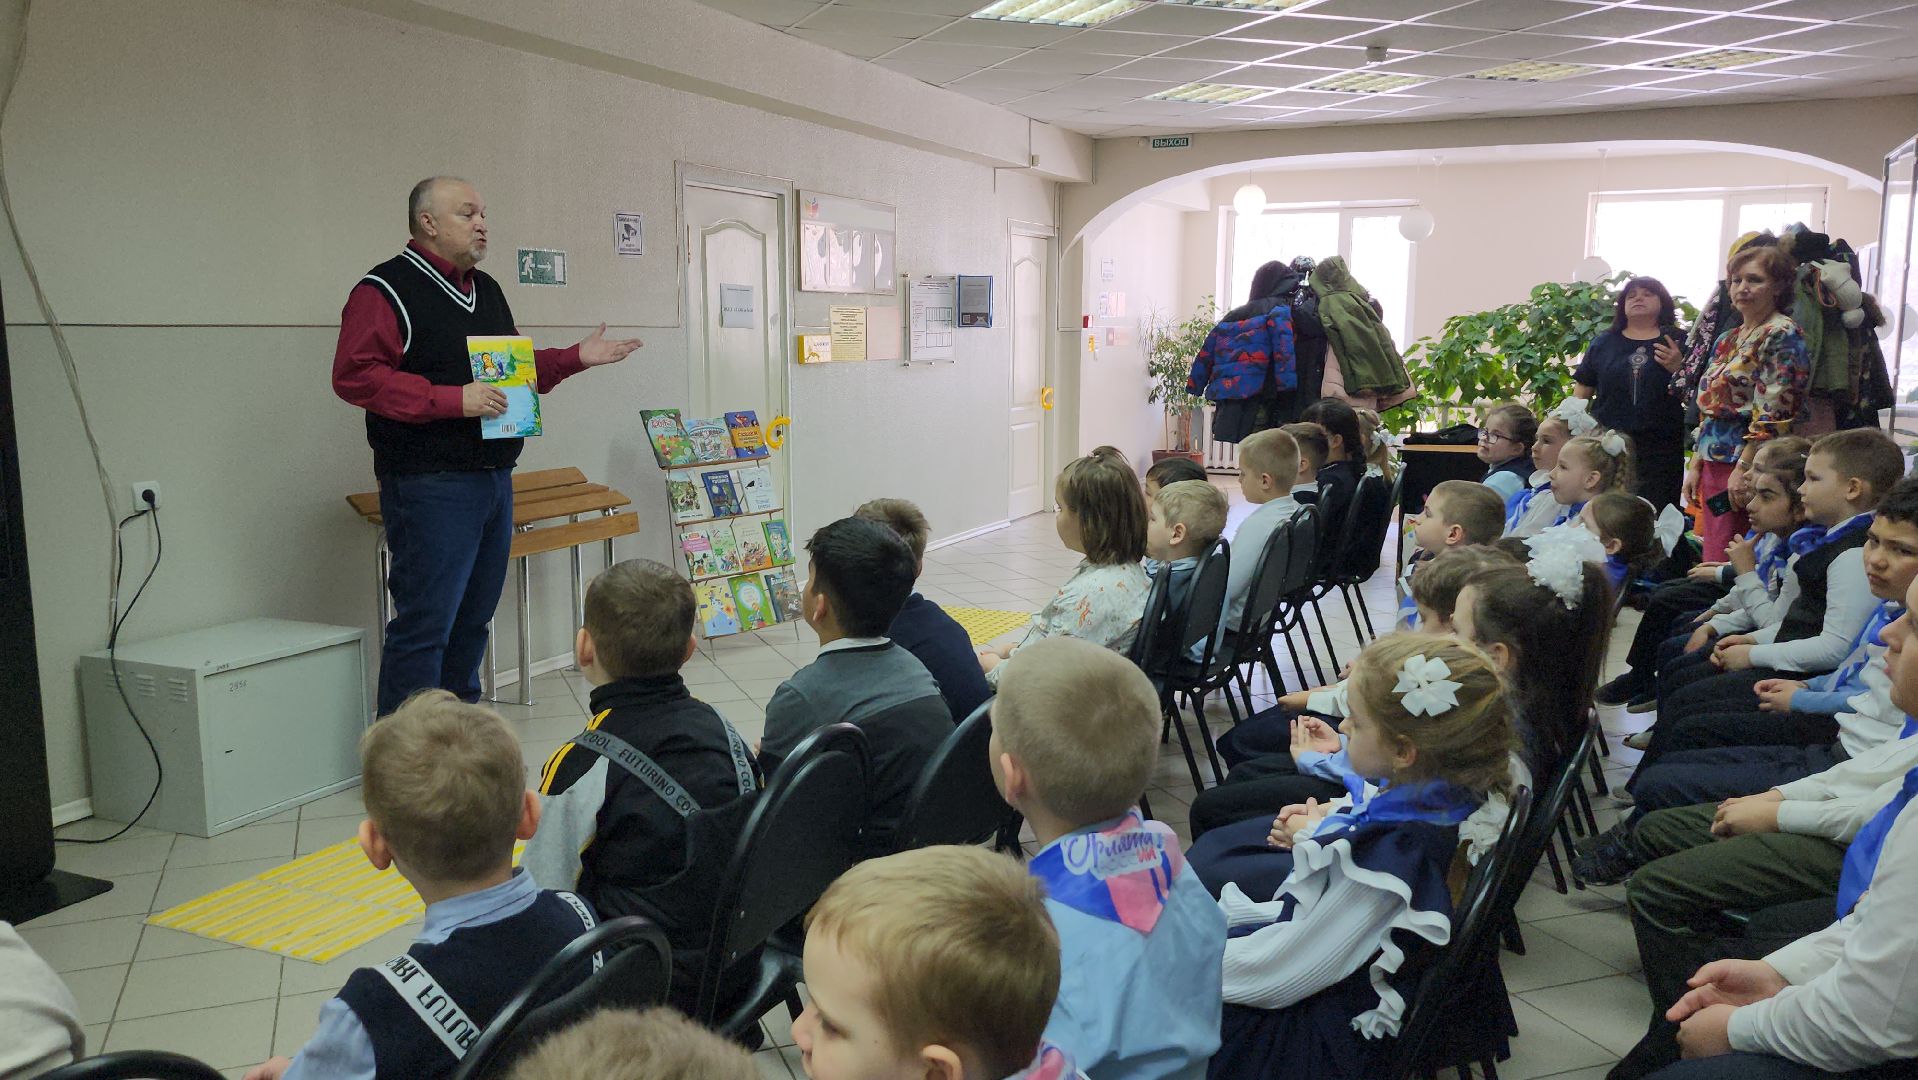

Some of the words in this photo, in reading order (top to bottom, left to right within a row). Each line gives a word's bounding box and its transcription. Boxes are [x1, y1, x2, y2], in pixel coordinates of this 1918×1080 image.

[1154, 138, 1187, 147] ВЫХОД
[582, 731, 612, 752] COOL
[618, 748, 675, 797] FUTURINO
